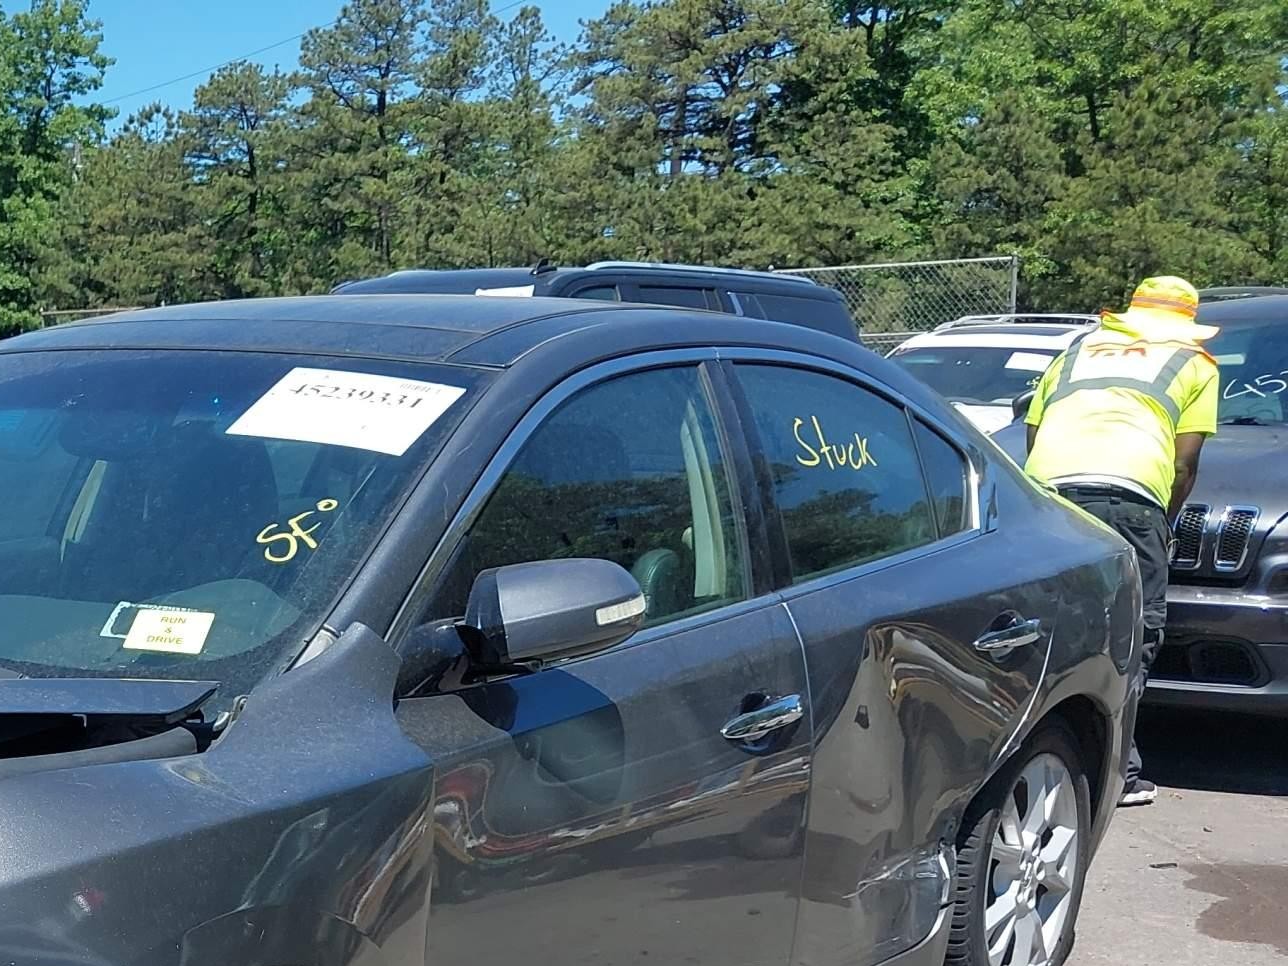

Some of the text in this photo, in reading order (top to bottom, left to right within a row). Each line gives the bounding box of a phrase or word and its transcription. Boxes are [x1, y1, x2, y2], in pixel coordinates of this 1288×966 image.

[289, 382, 423, 408] 45239331
[1223, 370, 1288, 400] 45
[794, 415, 877, 470] Stuck
[160, 616, 186, 624] RUN
[146, 635, 183, 645] DRIVE
